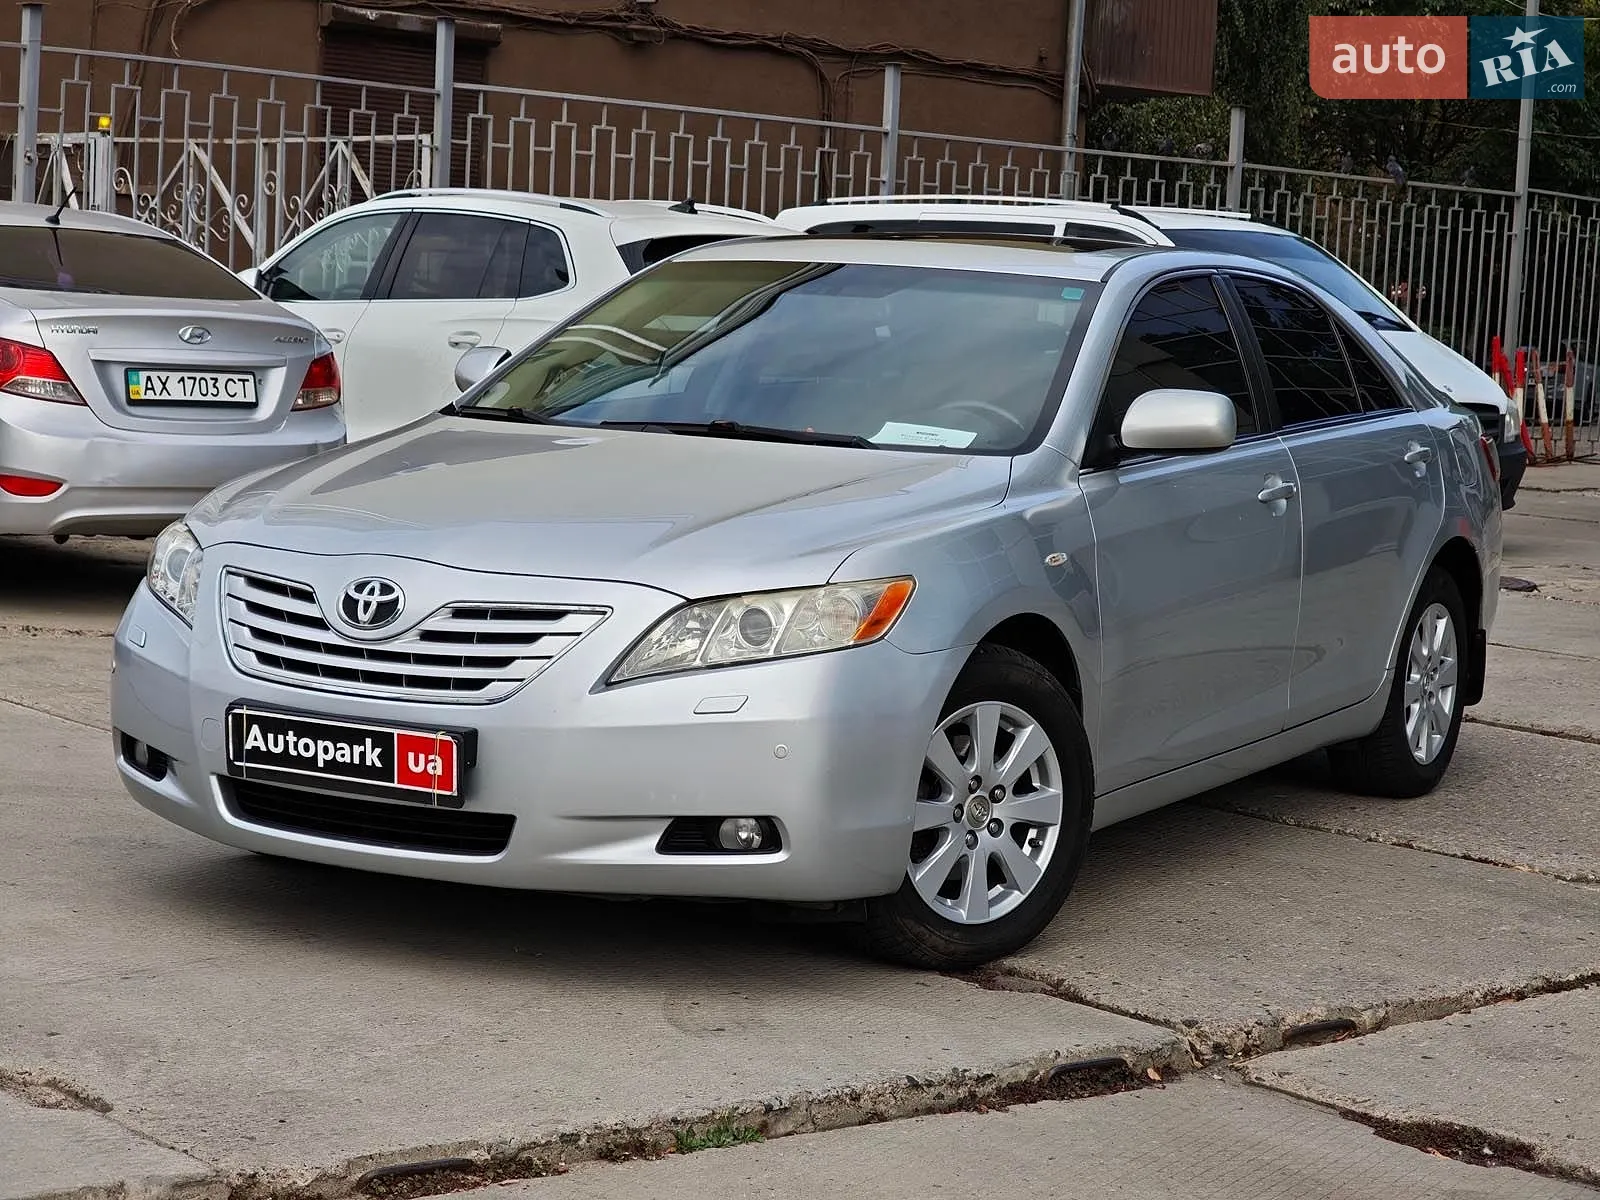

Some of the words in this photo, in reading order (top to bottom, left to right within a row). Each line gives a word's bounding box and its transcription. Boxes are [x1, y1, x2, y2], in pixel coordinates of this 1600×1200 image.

[51, 324, 98, 334] HYUNDAI
[144, 375, 171, 396] AX
[177, 376, 220, 397] 1703
[224, 378, 250, 398] CT
[244, 724, 383, 768] Autopark
[407, 751, 443, 776] ua
